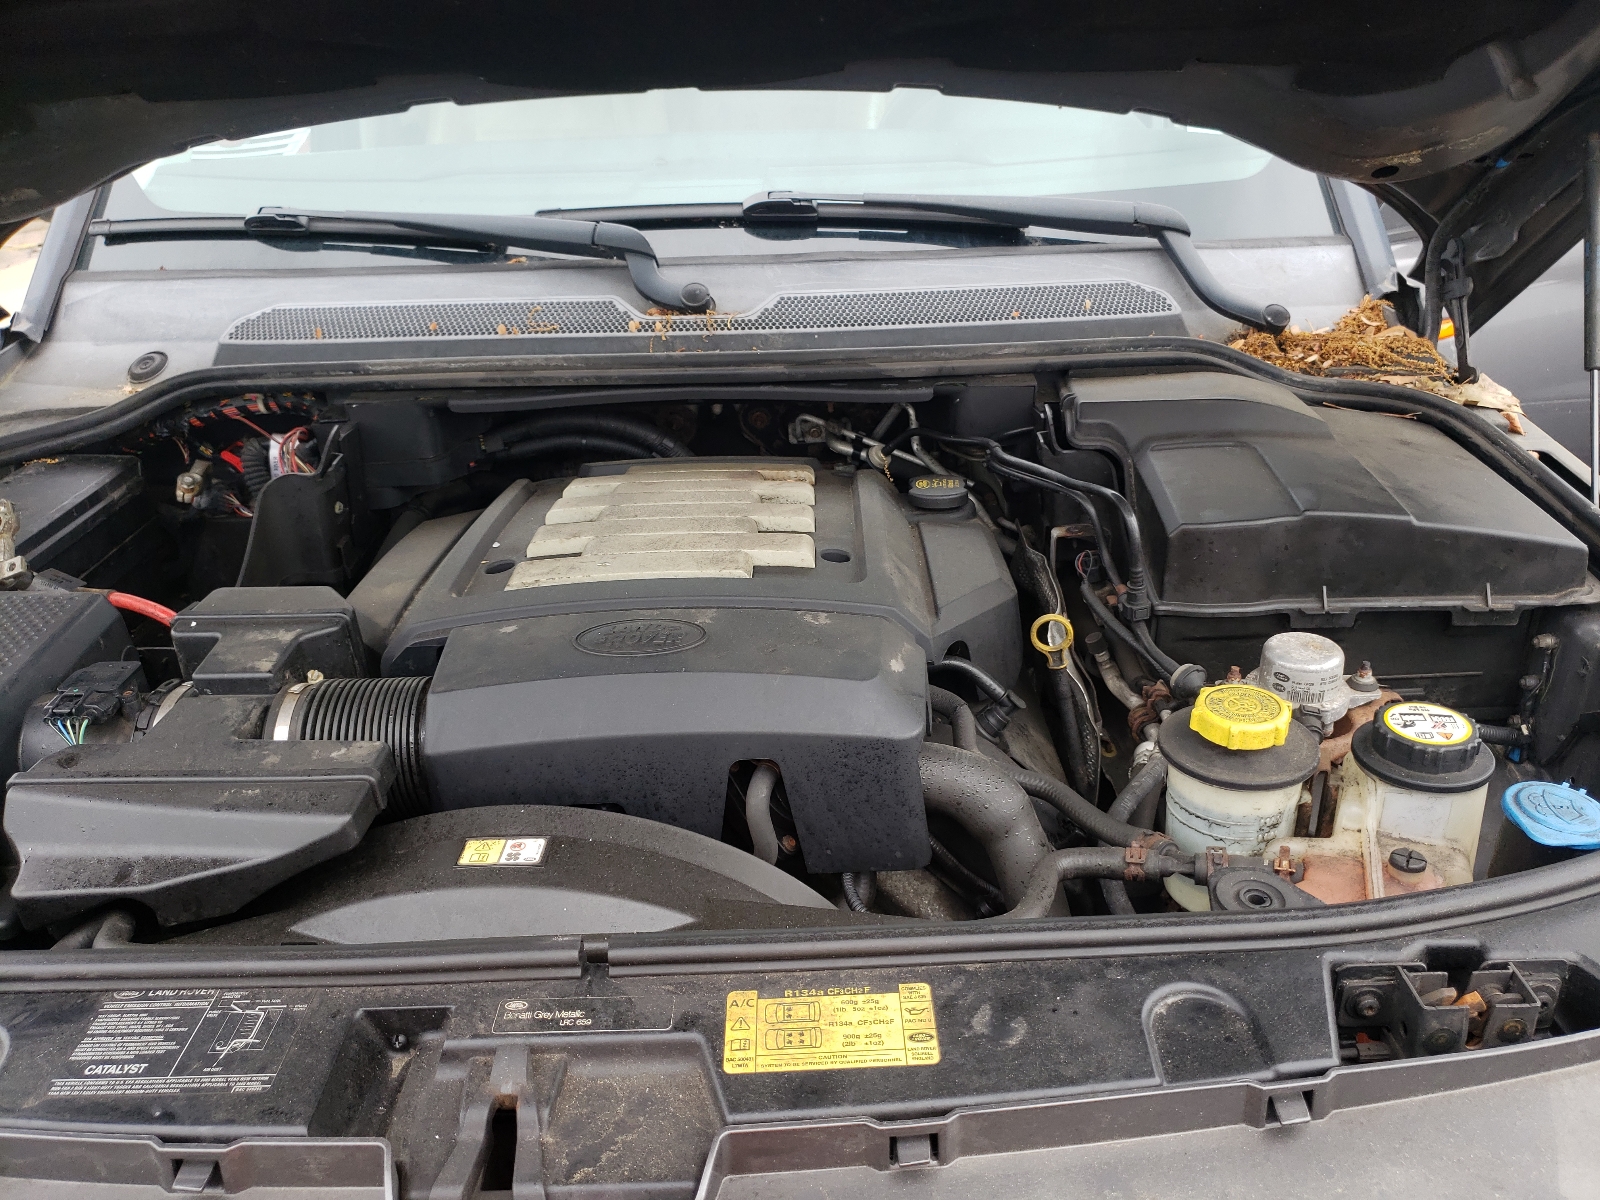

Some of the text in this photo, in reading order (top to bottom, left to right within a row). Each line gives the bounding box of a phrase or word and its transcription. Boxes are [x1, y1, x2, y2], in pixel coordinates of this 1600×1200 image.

[784, 989, 824, 997] R134a
[729, 999, 755, 1008] A/C
[534, 1010, 553, 1020] Grey
[555, 1010, 585, 1019] Metallic
[84, 1063, 149, 1075] CATALYST
